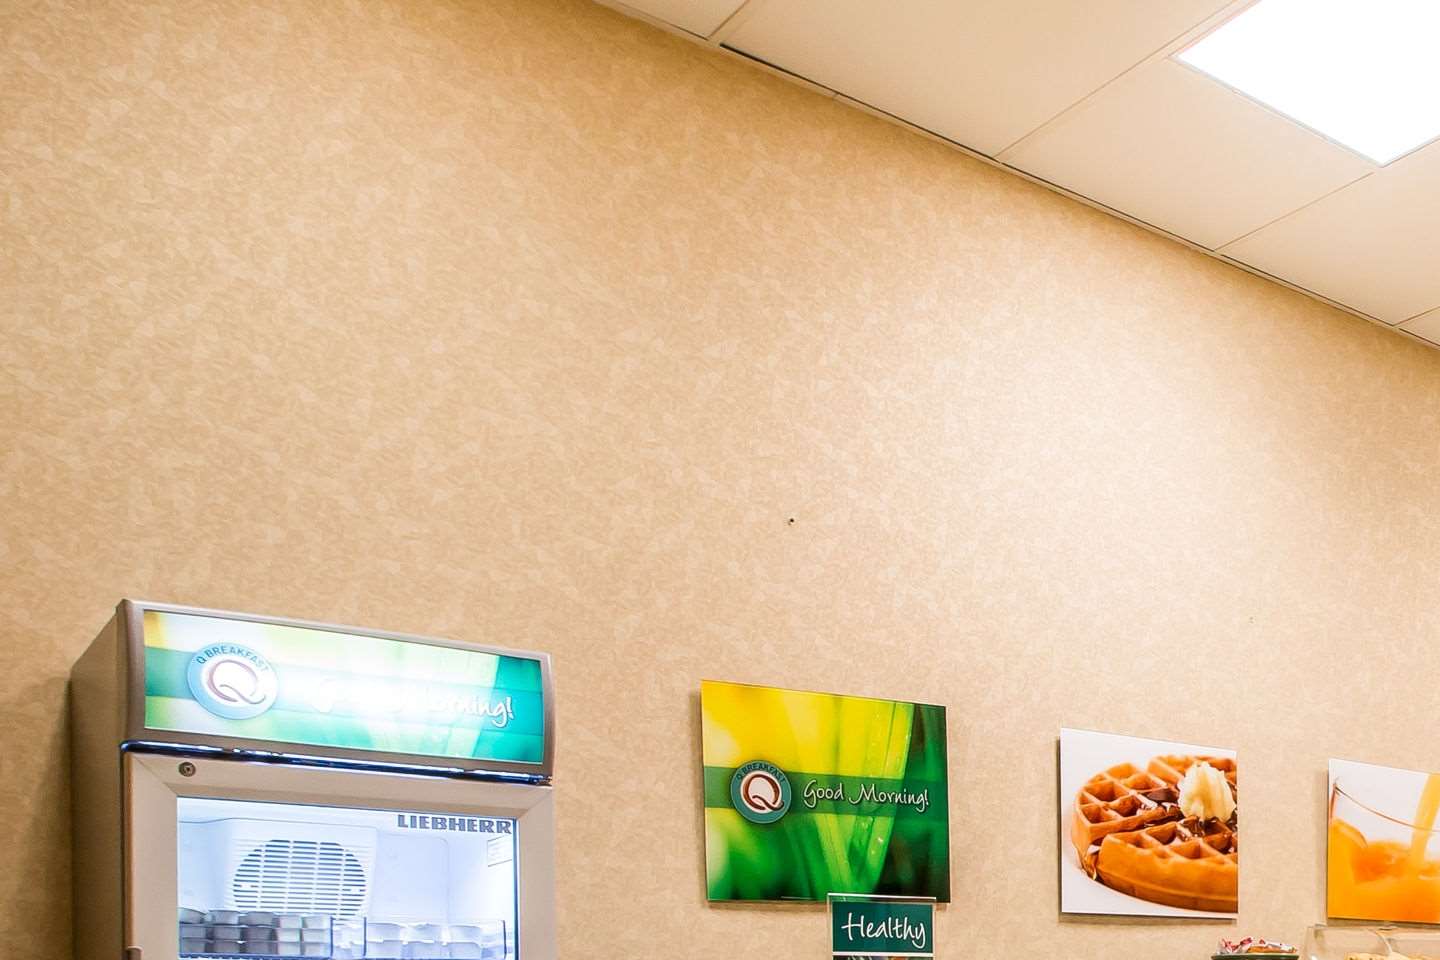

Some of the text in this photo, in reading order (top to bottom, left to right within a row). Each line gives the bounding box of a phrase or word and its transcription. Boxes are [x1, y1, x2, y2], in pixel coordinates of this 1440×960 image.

[803, 779, 929, 813] Good Morning!
[397, 814, 512, 834] LIEBHERR
[841, 912, 926, 949] Healthy
